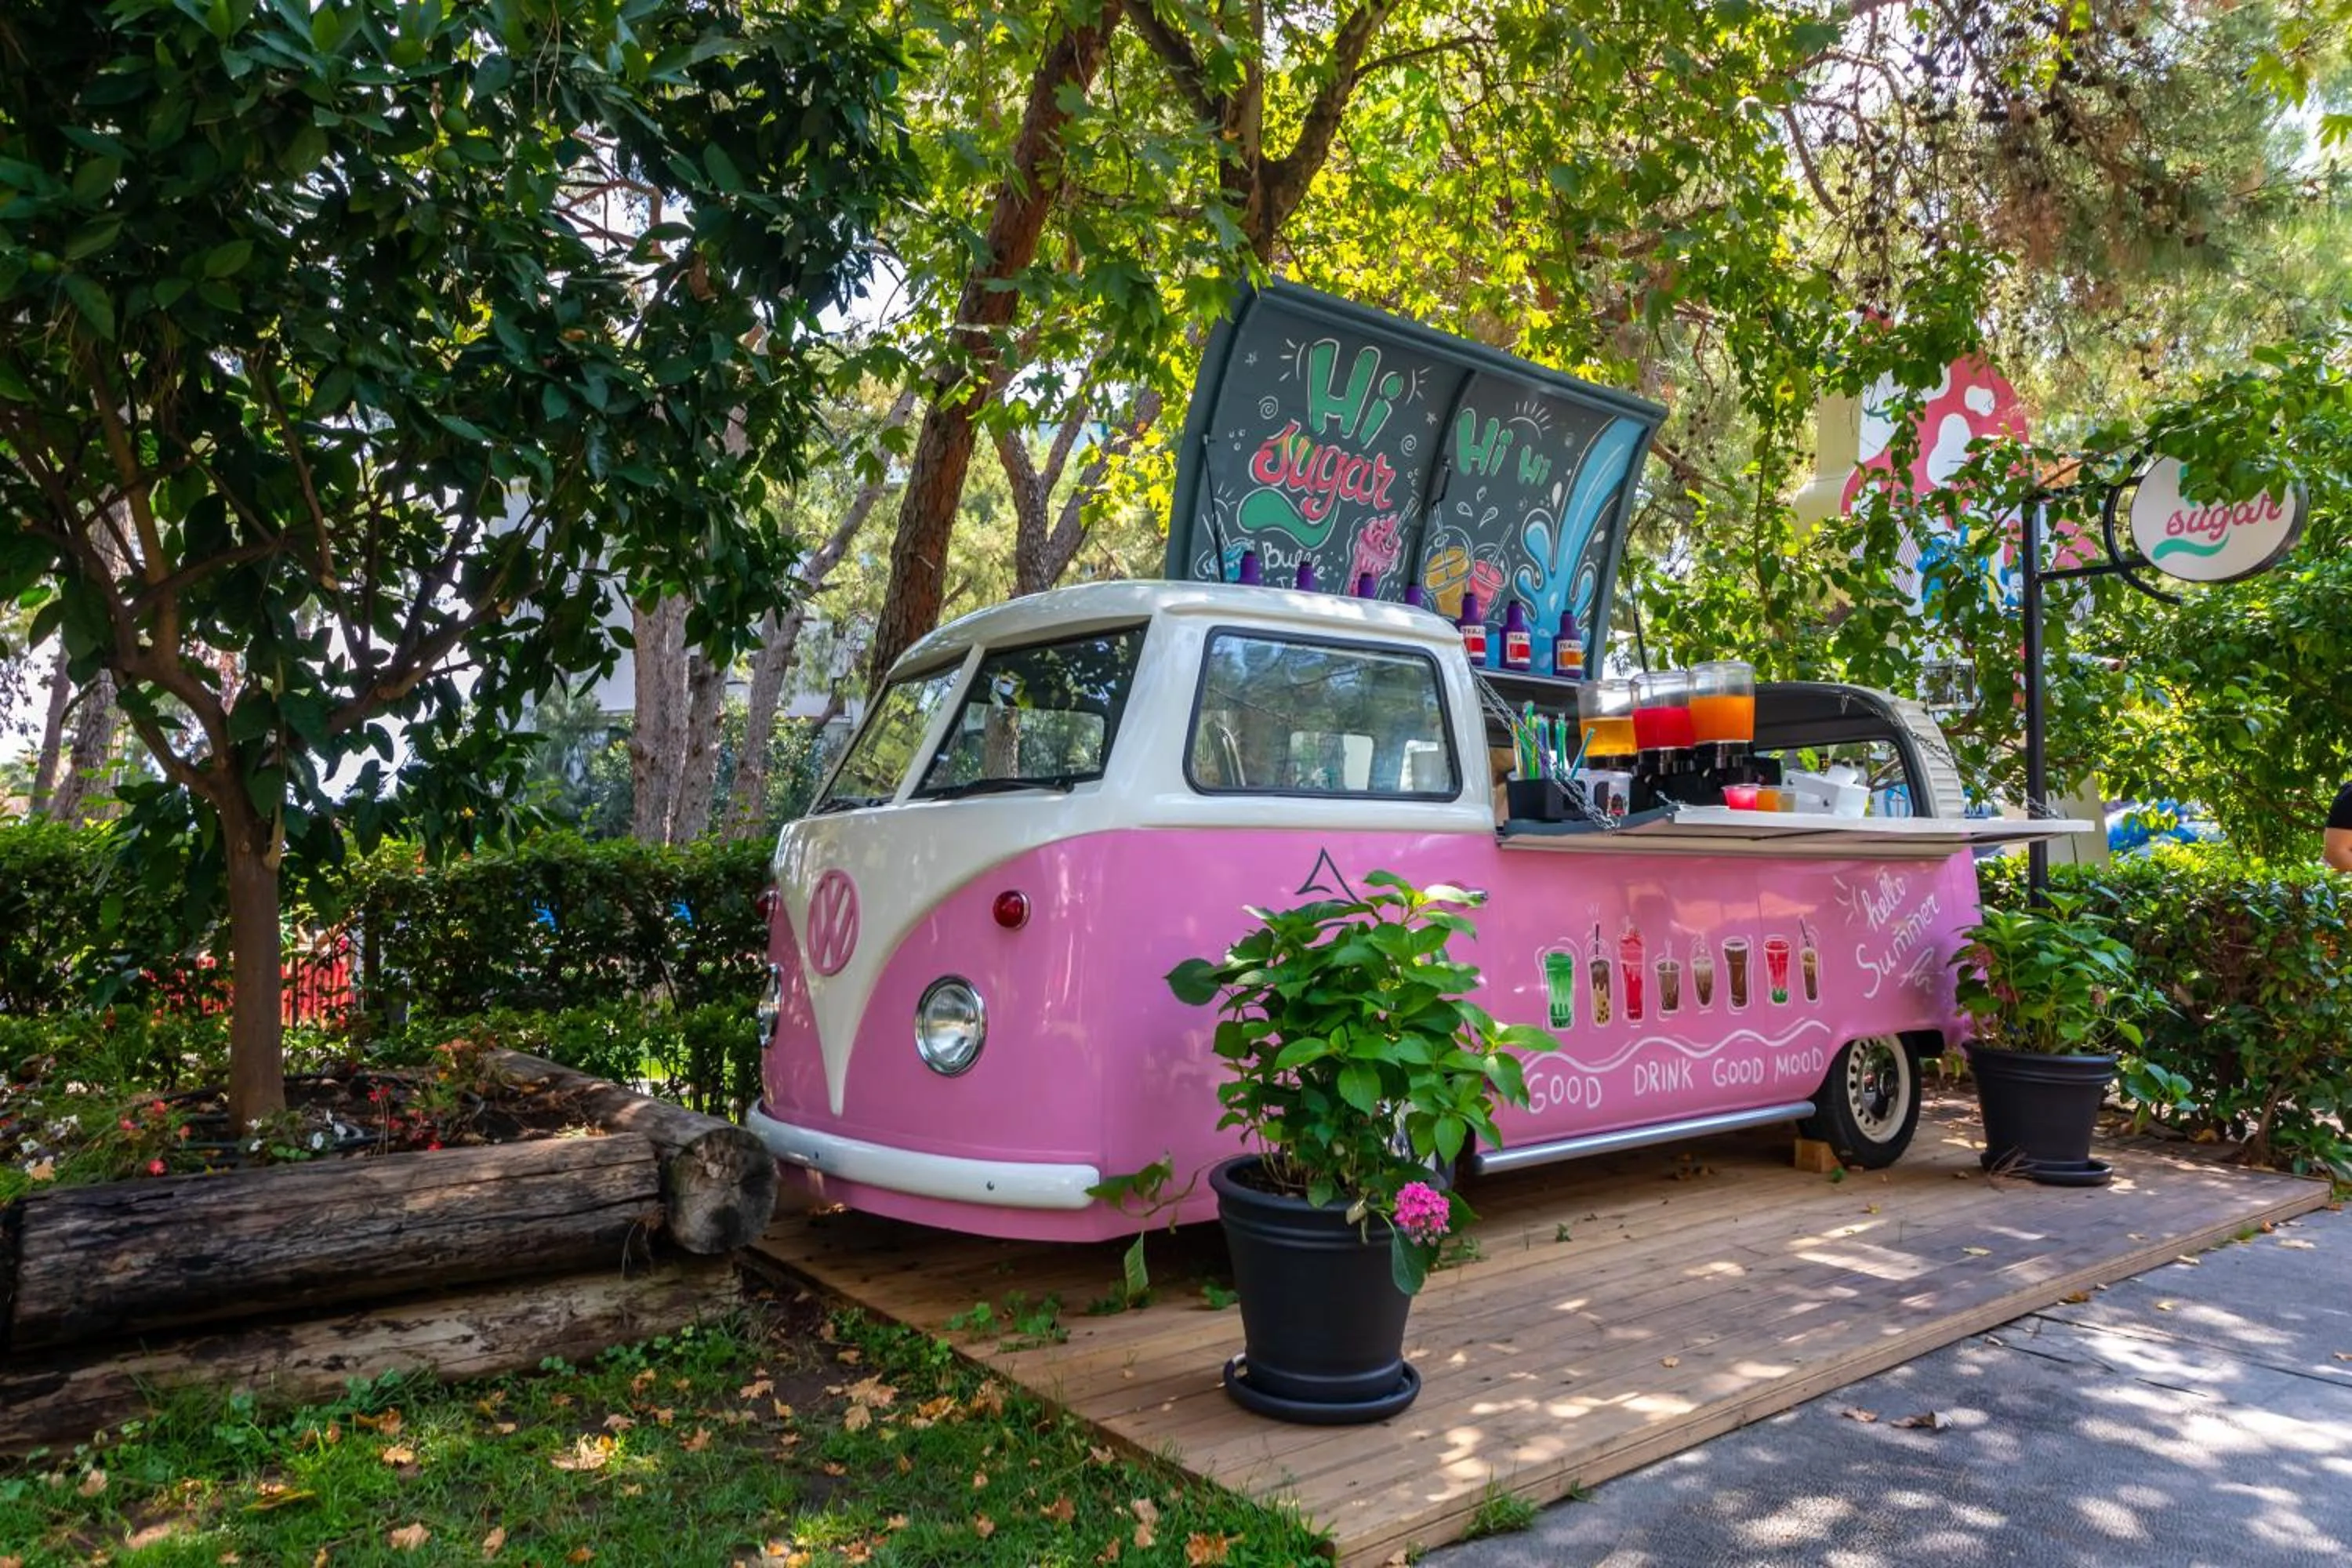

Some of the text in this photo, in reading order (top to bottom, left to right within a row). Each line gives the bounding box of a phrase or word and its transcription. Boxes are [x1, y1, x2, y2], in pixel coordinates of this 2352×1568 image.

[1306, 338, 1404, 450] Hi
[1456, 407, 1514, 477] Hi
[1860, 871, 1907, 933] hello
[1526, 1047, 1824, 1114] GOOD DRINK GOOD MOOD
